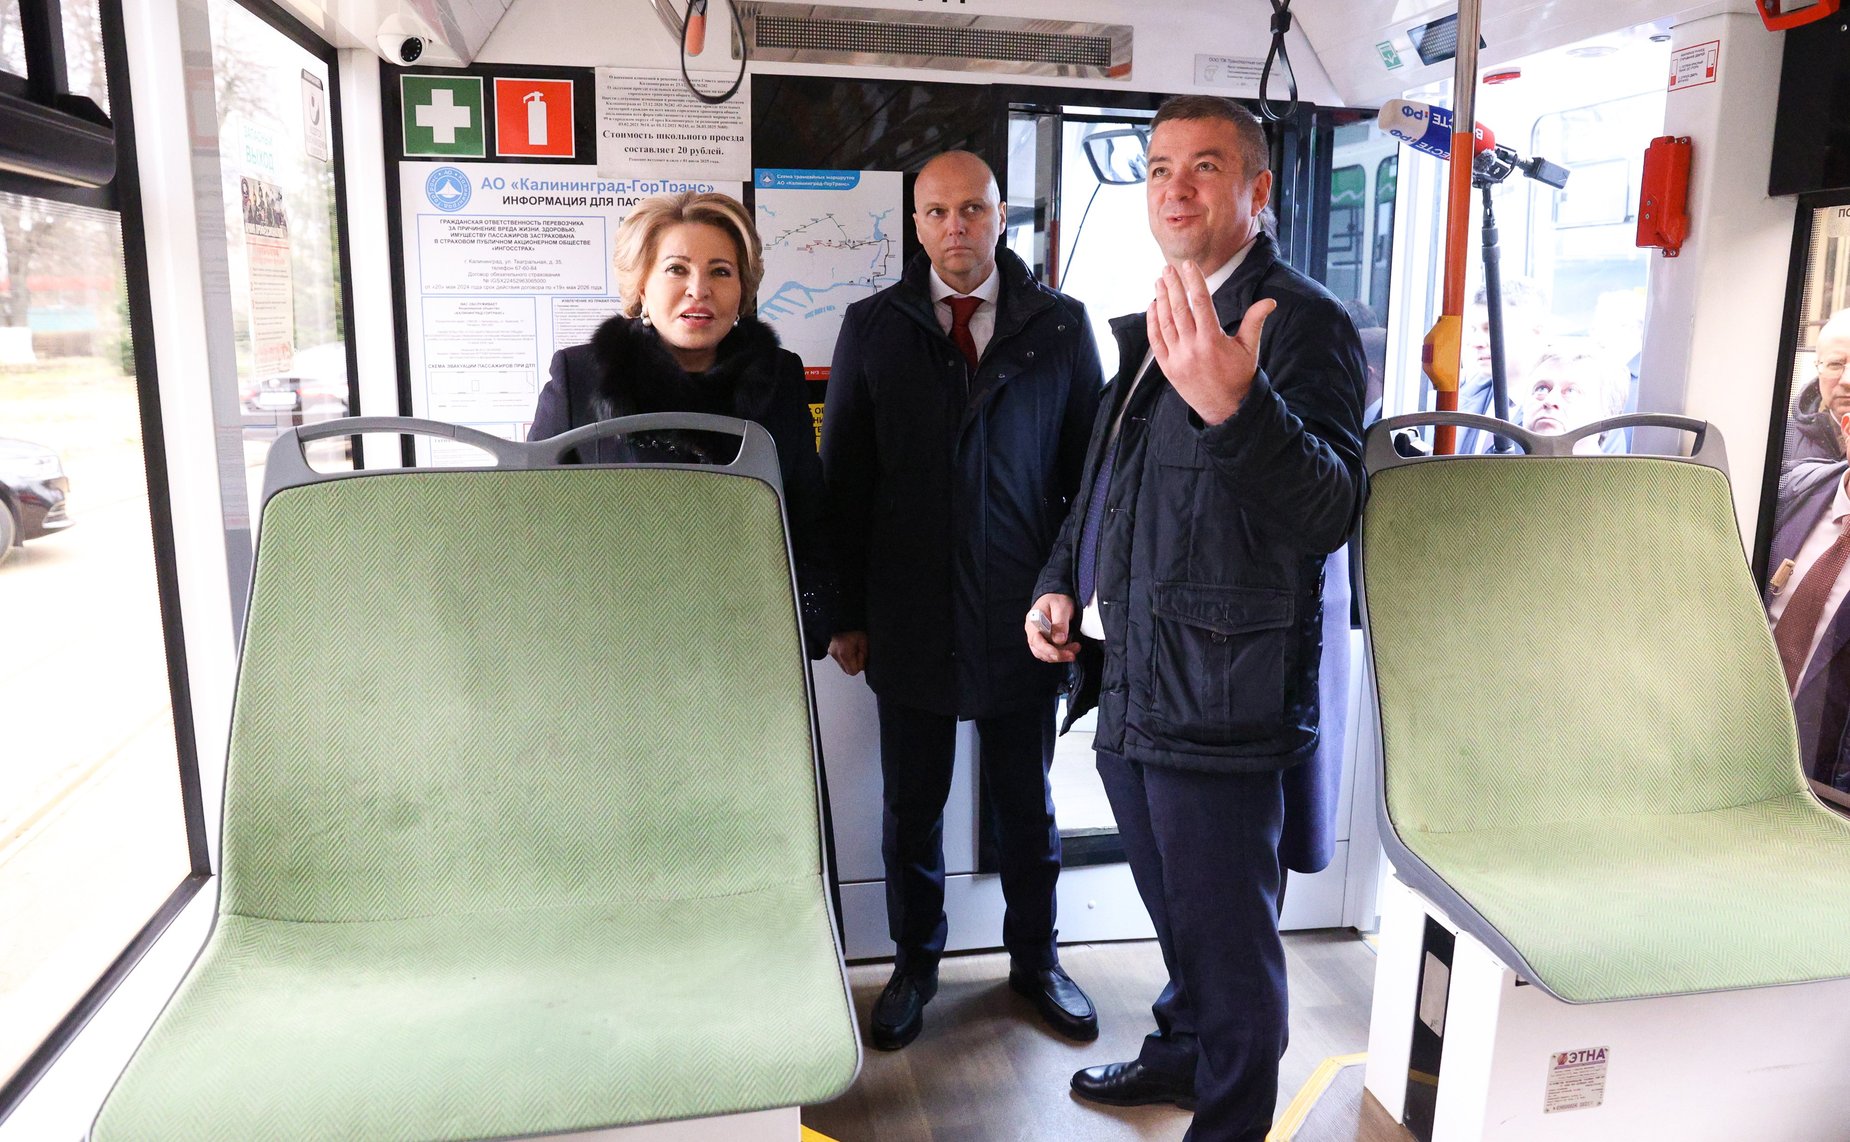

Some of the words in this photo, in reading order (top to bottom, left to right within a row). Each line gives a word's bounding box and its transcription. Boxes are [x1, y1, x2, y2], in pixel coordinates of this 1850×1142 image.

[602, 130, 654, 140] Стоимость
[656, 132, 707, 142] школьного
[709, 133, 745, 143] проезда
[624, 145, 675, 155] составляет
[677, 146, 688, 154] 20
[689, 147, 724, 157] рублей.
[245, 145, 275, 174] ВЫХОД
[480, 176, 506, 190] АО
[511, 177, 714, 195] «Калининград-ГорТранс»
[502, 195, 587, 208] ИНФОРМАЦИЯ
[589, 197, 614, 208] ДЛЯ
[1568, 1047, 1606, 1064] ЭТНА
